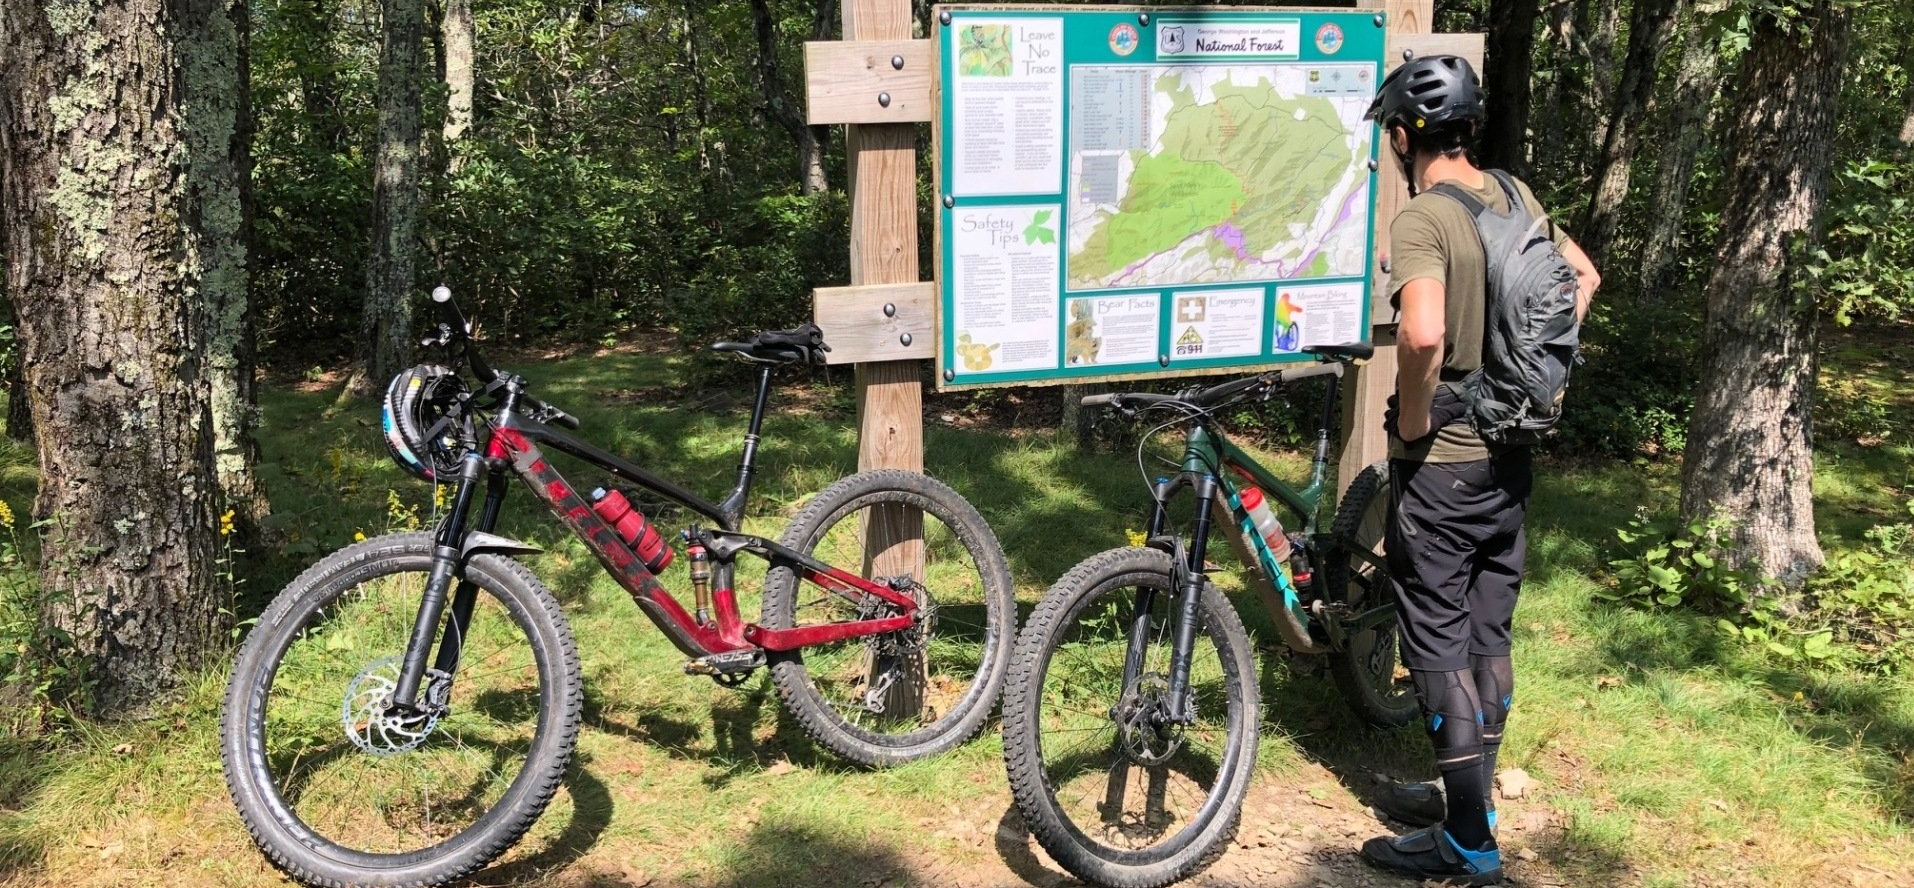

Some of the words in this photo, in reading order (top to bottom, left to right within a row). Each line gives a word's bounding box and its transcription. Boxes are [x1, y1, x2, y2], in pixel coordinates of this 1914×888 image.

[1020, 26, 1055, 43] Leave
[1029, 43, 1050, 59] No
[1196, 38, 1247, 53] National
[1249, 37, 1284, 51] Forest
[1022, 60, 1057, 76] Trace
[961, 213, 1014, 234] Safety
[986, 229, 1019, 249] Tips
[1097, 300, 1123, 314] Bear
[1128, 298, 1155, 312] Facts
[1208, 296, 1256, 310] Emergency
[1187, 344, 1203, 354] 911
